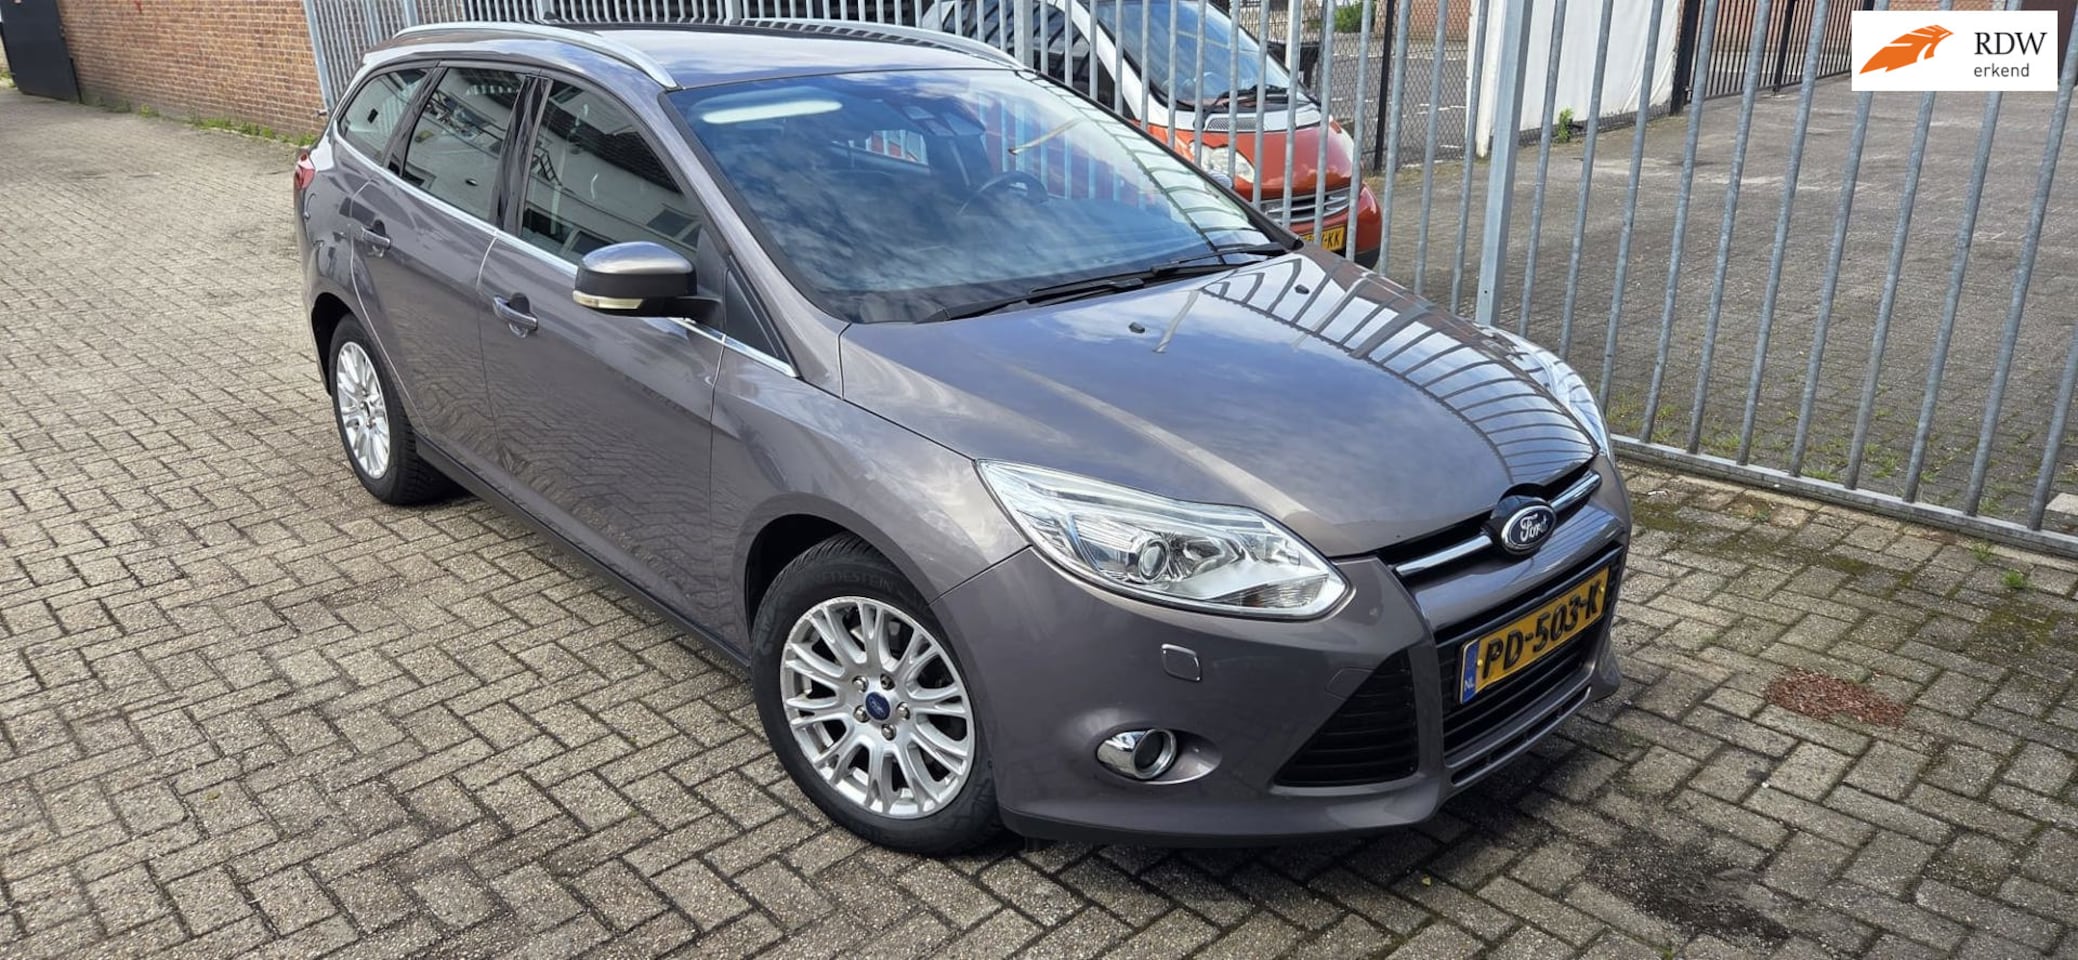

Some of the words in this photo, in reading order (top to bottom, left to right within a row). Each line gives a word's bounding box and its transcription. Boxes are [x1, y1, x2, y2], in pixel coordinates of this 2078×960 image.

[1519, 512, 1549, 543] Ford
[1482, 579, 1603, 680] PD-503-K
[1464, 678, 1474, 691] NL
